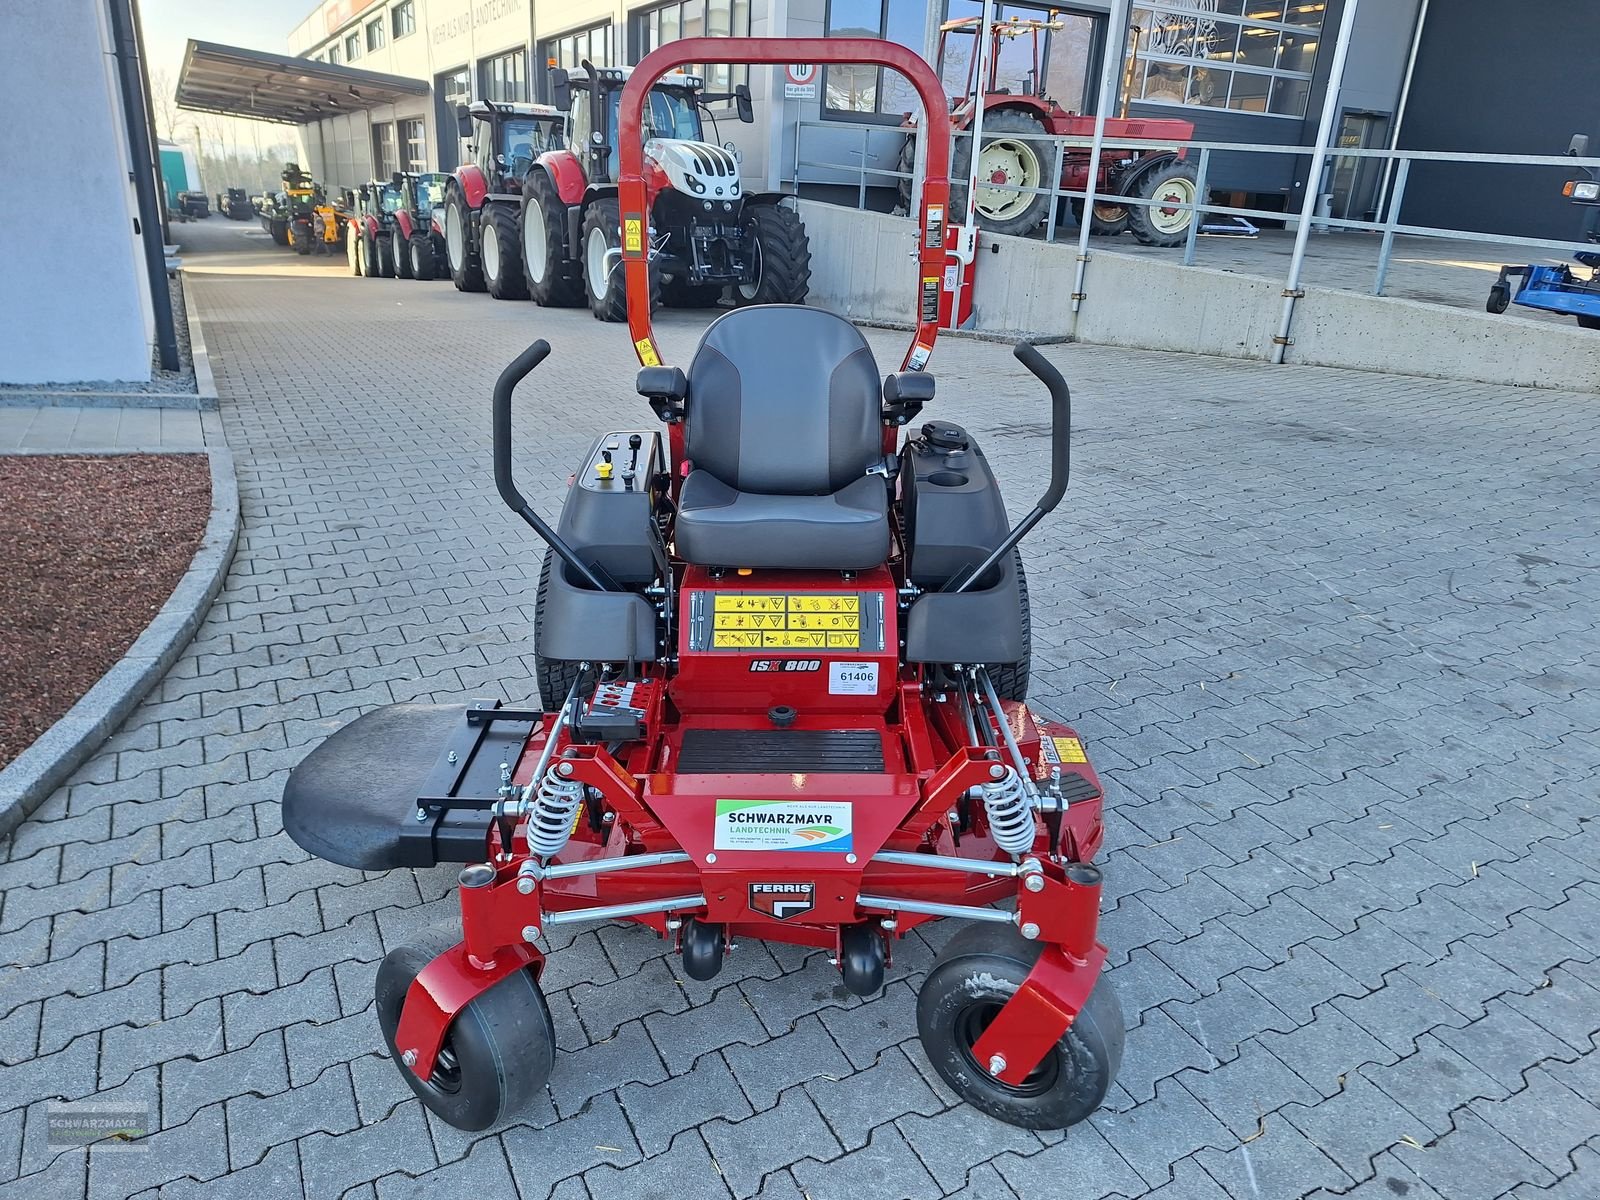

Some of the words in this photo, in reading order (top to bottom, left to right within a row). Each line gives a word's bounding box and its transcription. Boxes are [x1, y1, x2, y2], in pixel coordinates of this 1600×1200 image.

[796, 64, 806, 76] 10
[750, 660, 781, 672] ISX
[784, 660, 820, 671] 800
[840, 672, 874, 681] 61406
[1042, 737, 1056, 761] TRPLE
[728, 812, 832, 824] SCHWARZMAYR
[754, 884, 810, 892] FERRIS
